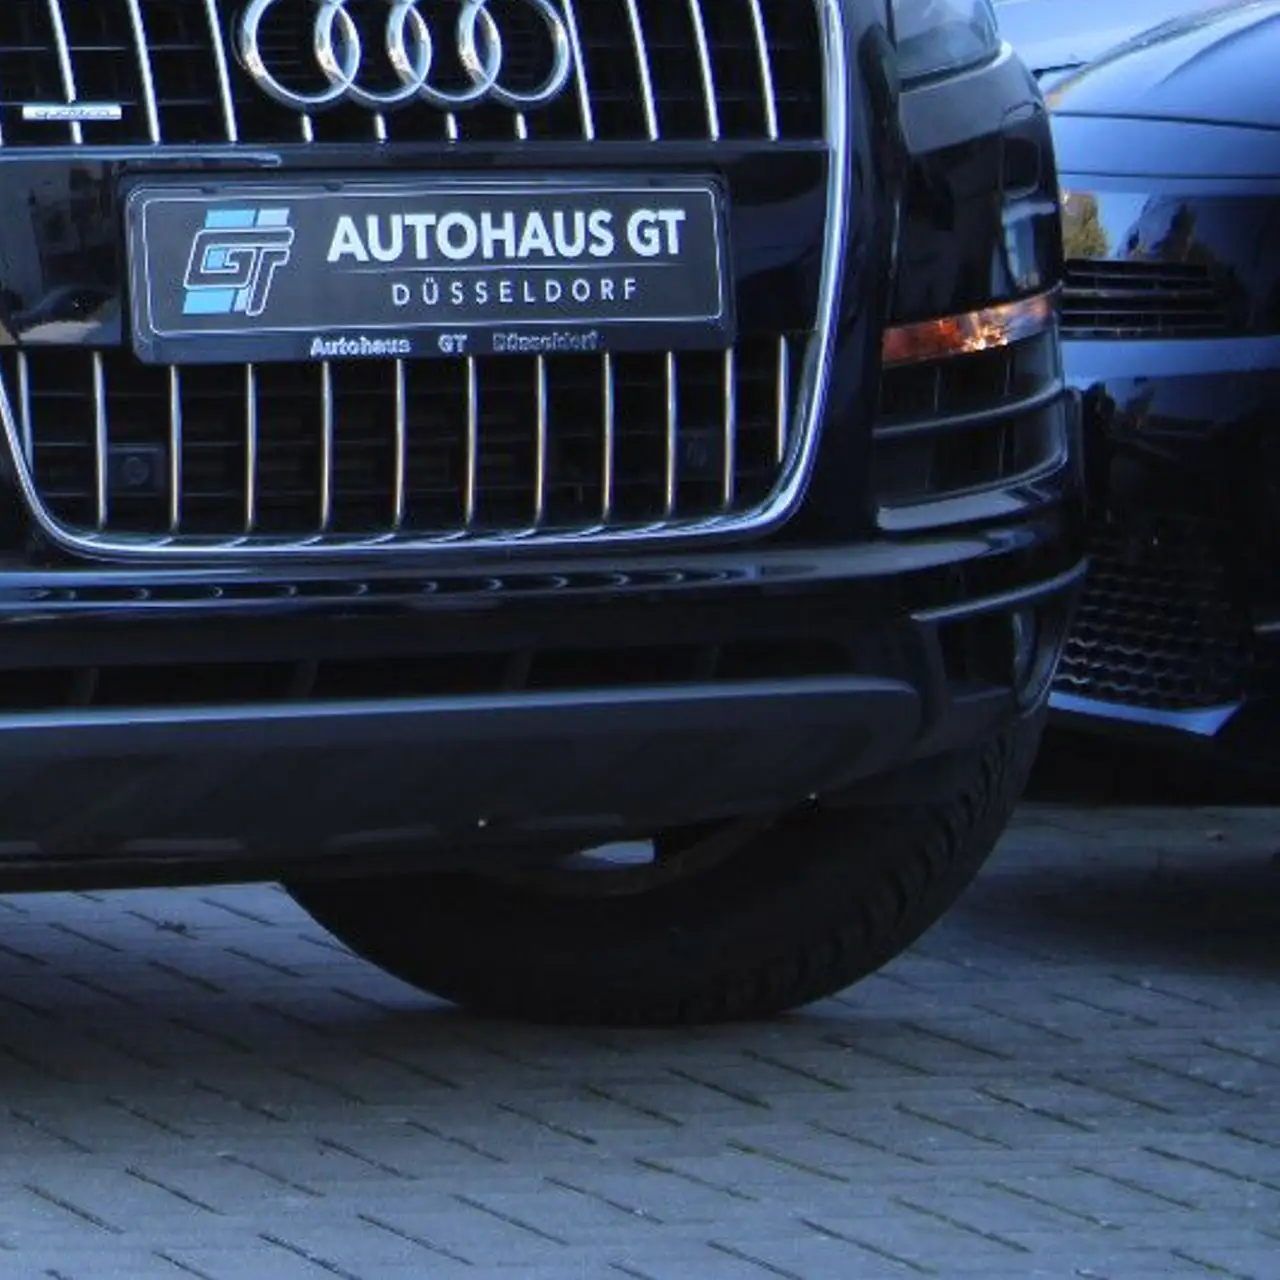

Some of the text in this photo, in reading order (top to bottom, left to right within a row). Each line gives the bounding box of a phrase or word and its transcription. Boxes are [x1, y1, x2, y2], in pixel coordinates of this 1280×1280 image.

[327, 209, 686, 262] AUTOHAUS GT
[391, 276, 637, 306] DÜSSELDORF
[310, 335, 412, 357] Autohaus
[437, 333, 468, 354] GT
